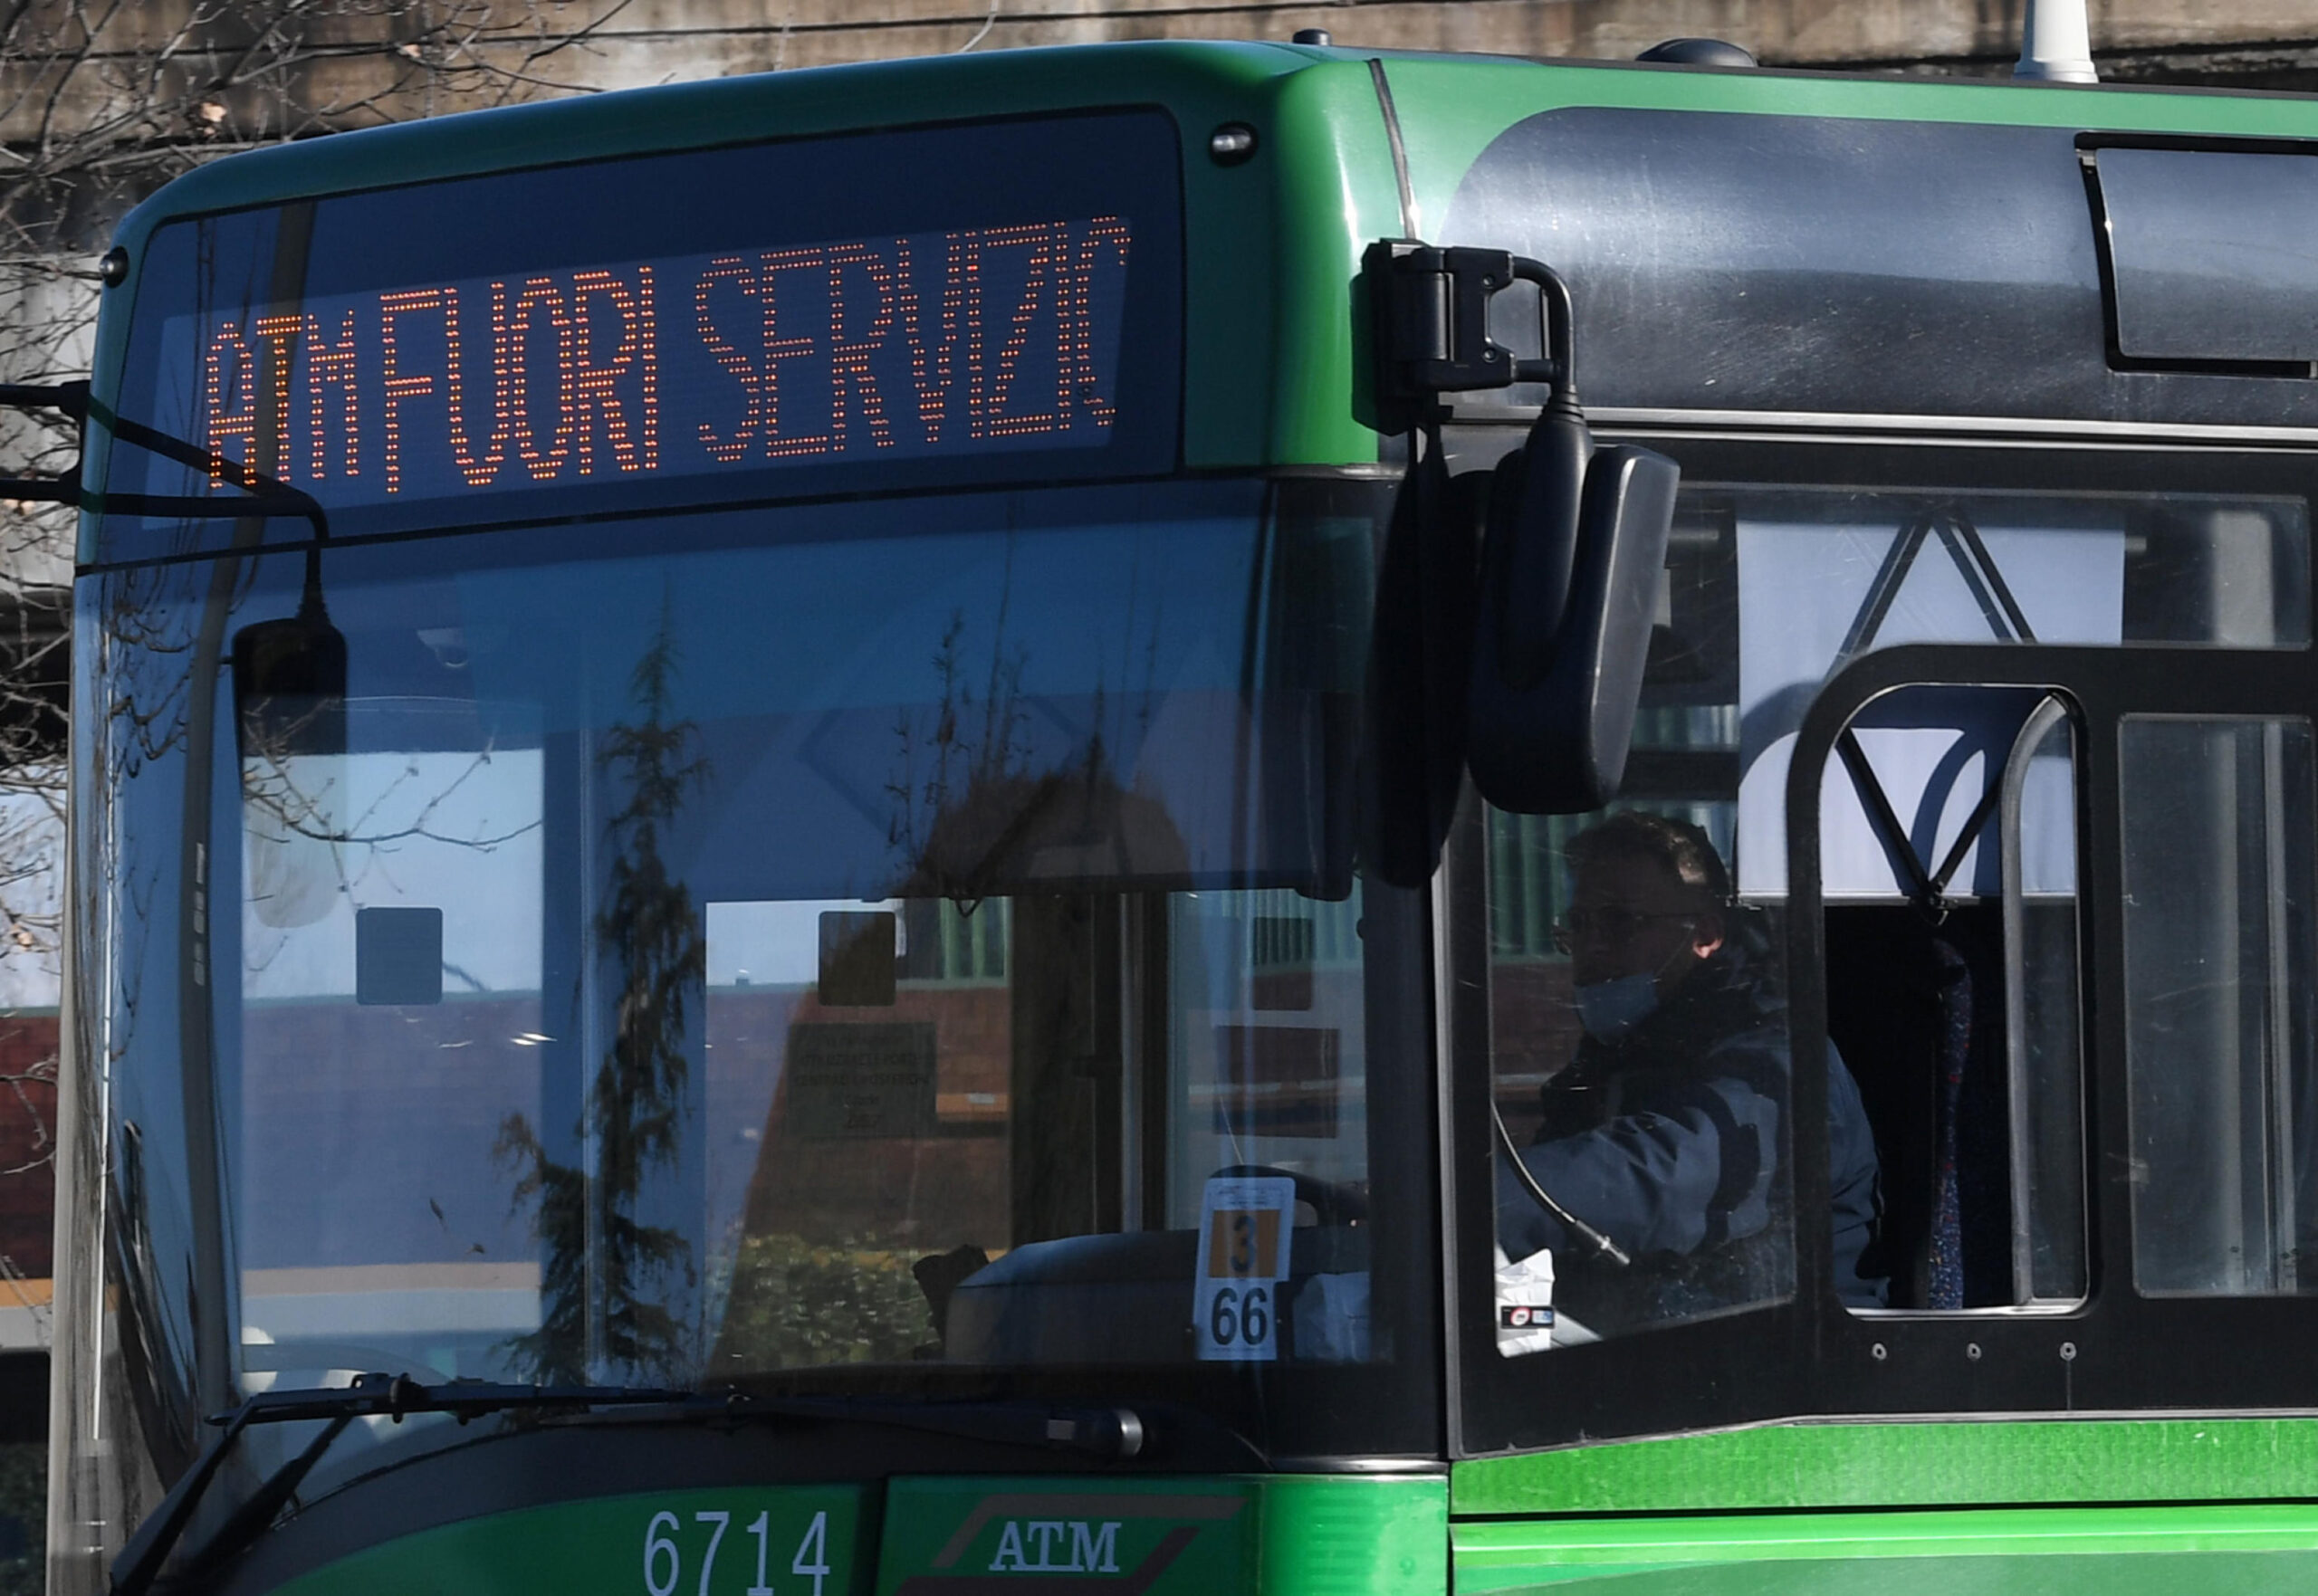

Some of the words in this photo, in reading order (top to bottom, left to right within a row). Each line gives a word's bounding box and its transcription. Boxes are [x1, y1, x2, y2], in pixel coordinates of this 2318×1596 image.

[206, 308, 359, 489] ATM
[379, 266, 659, 493] FUORI
[1229, 1214, 1257, 1274] 3
[1211, 1286, 1268, 1346] 66
[643, 1510, 830, 1596] 6714
[988, 1521, 1122, 1573] ATM
